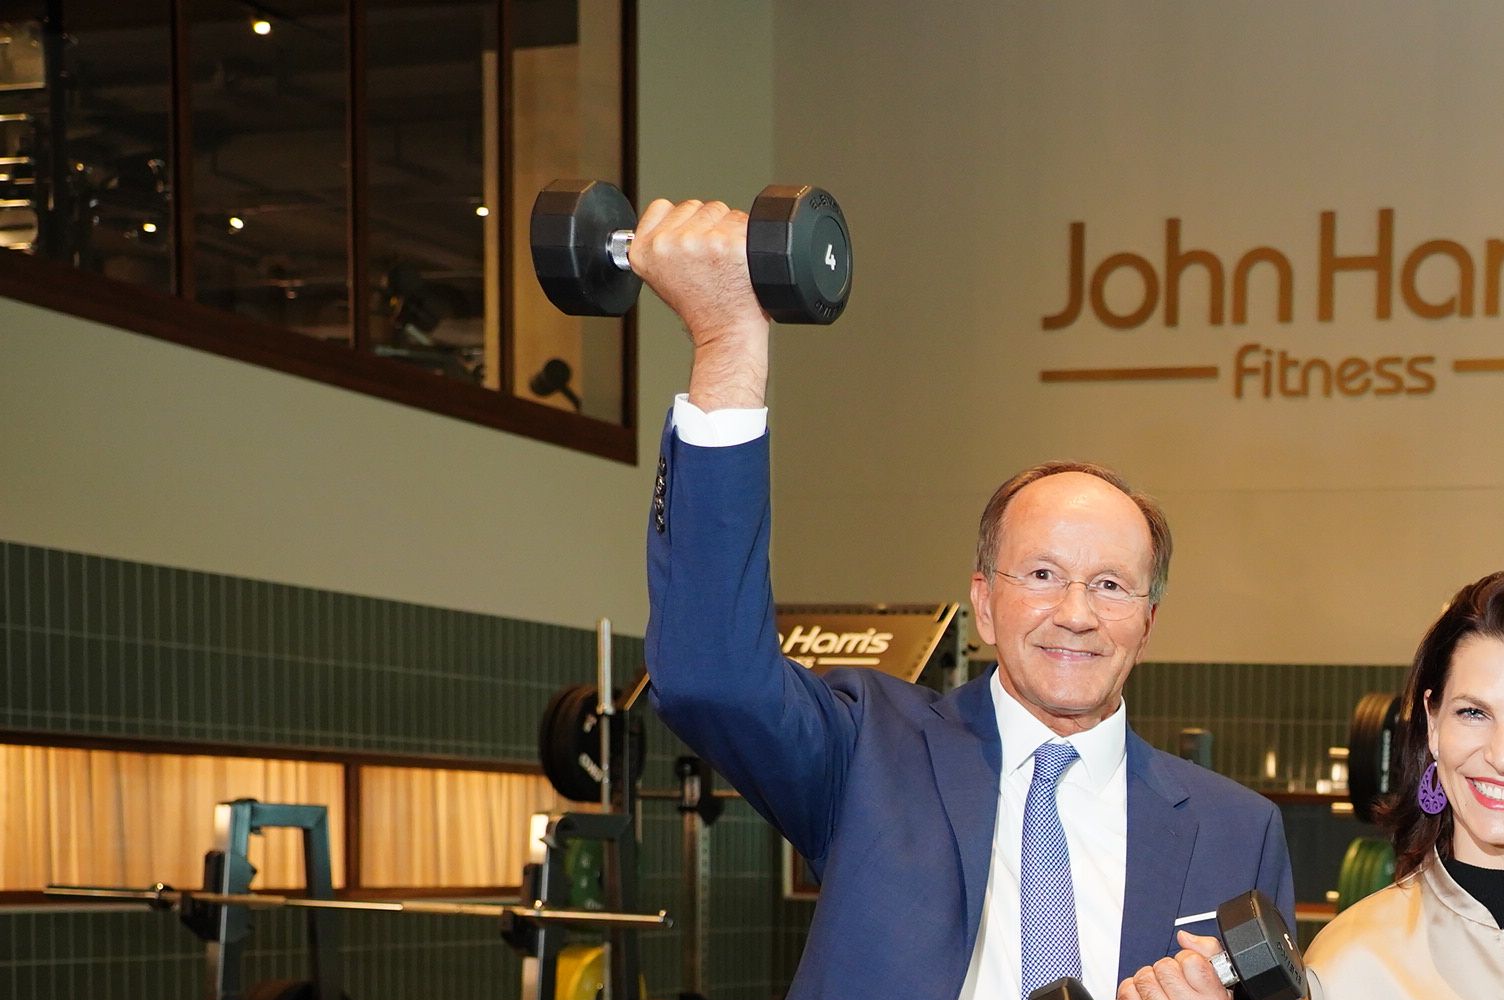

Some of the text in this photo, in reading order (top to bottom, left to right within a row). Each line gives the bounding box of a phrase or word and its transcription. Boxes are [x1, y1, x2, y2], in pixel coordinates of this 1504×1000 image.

[825, 243, 836, 271] 4
[1042, 217, 1293, 330] John
[1234, 343, 1437, 399] Fitness
[782, 625, 894, 654] Harris
